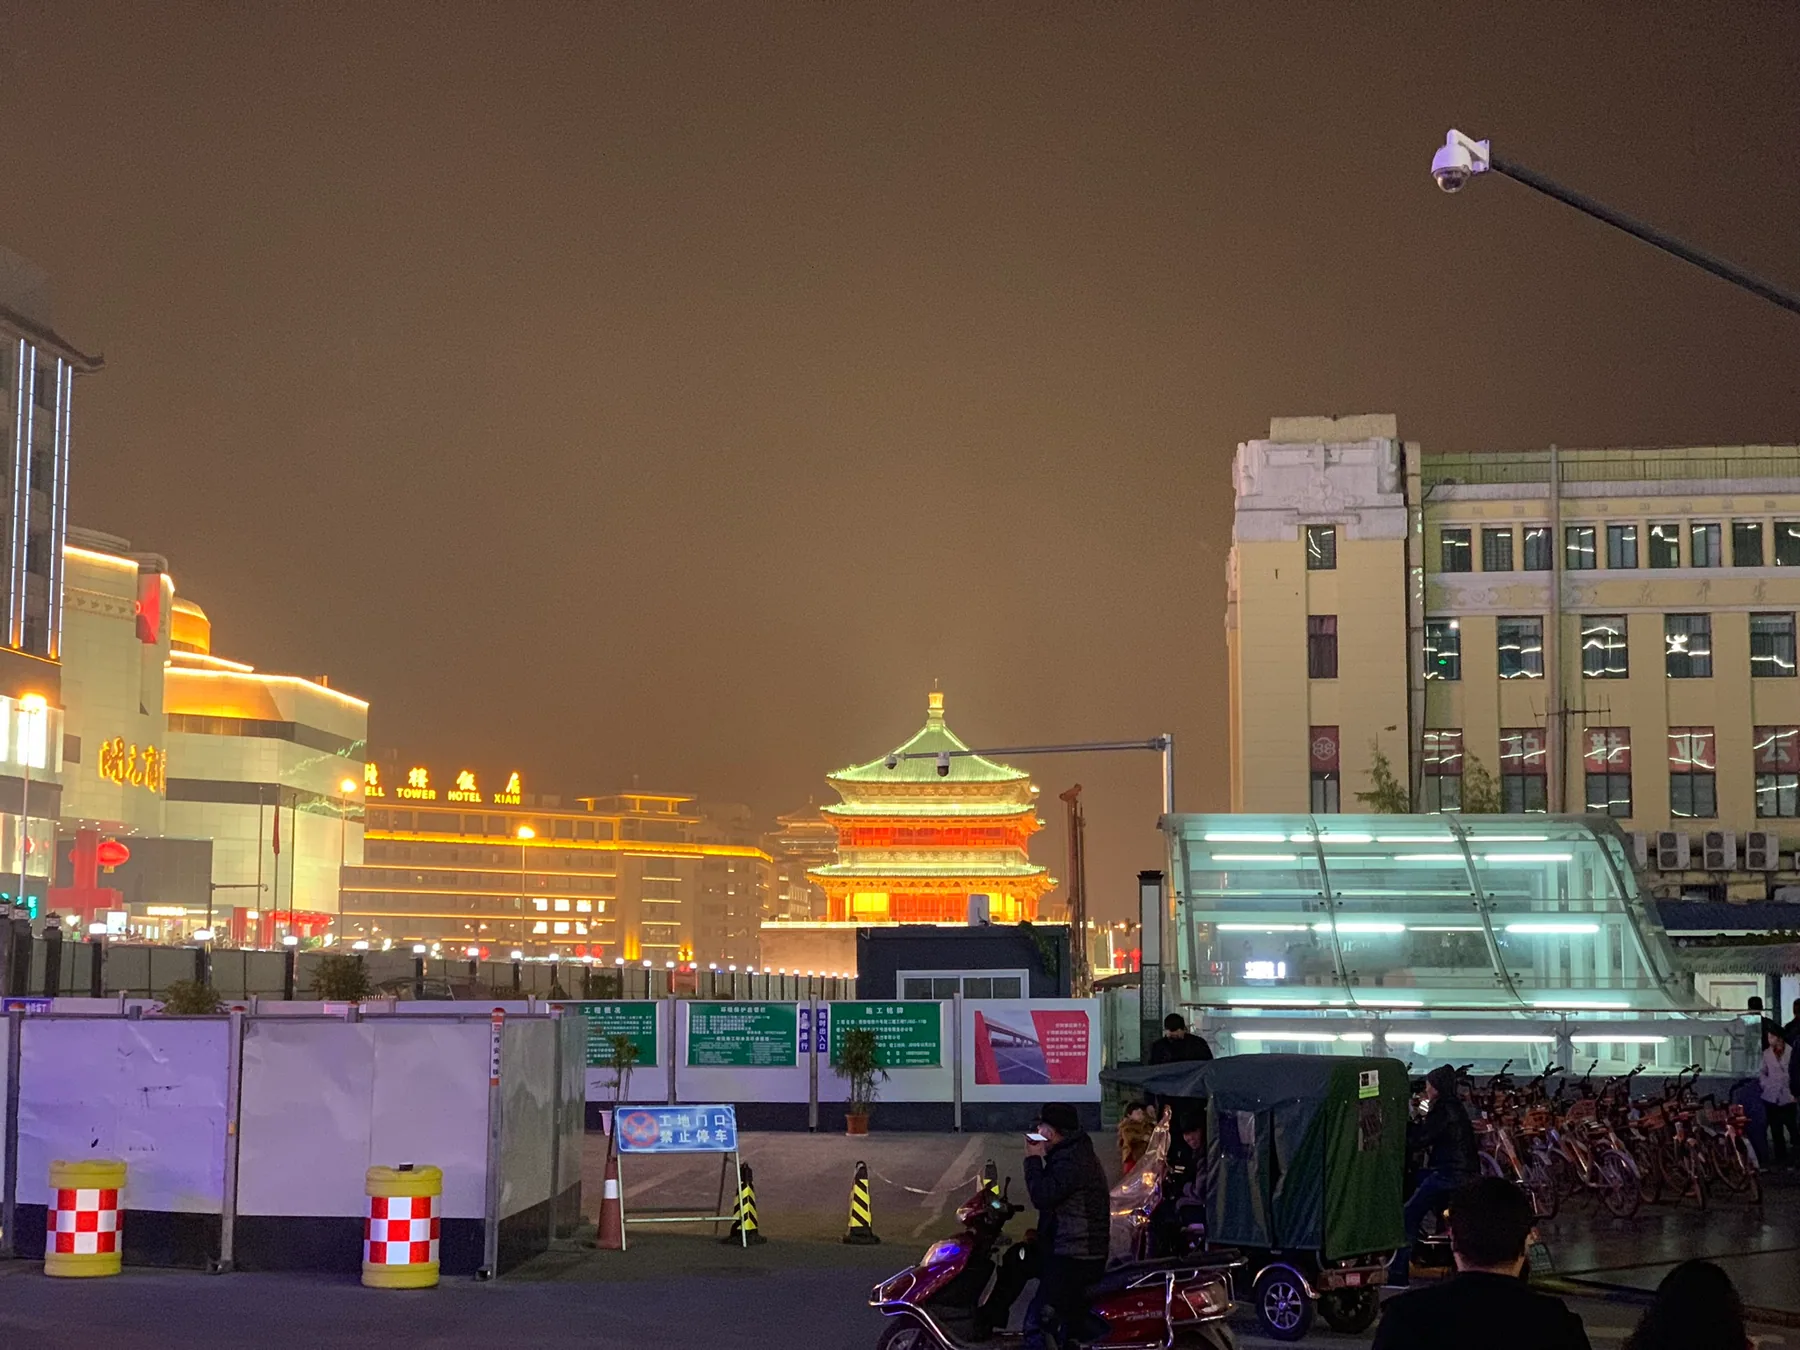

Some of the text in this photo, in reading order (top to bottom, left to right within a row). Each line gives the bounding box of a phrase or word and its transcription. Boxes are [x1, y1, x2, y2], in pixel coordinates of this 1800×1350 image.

[365, 786, 521, 805] ELL TOWER HOTEL XIAN
[659, 1114, 726, 1127] 工地门口
[660, 1129, 728, 1143] 禁止停车
